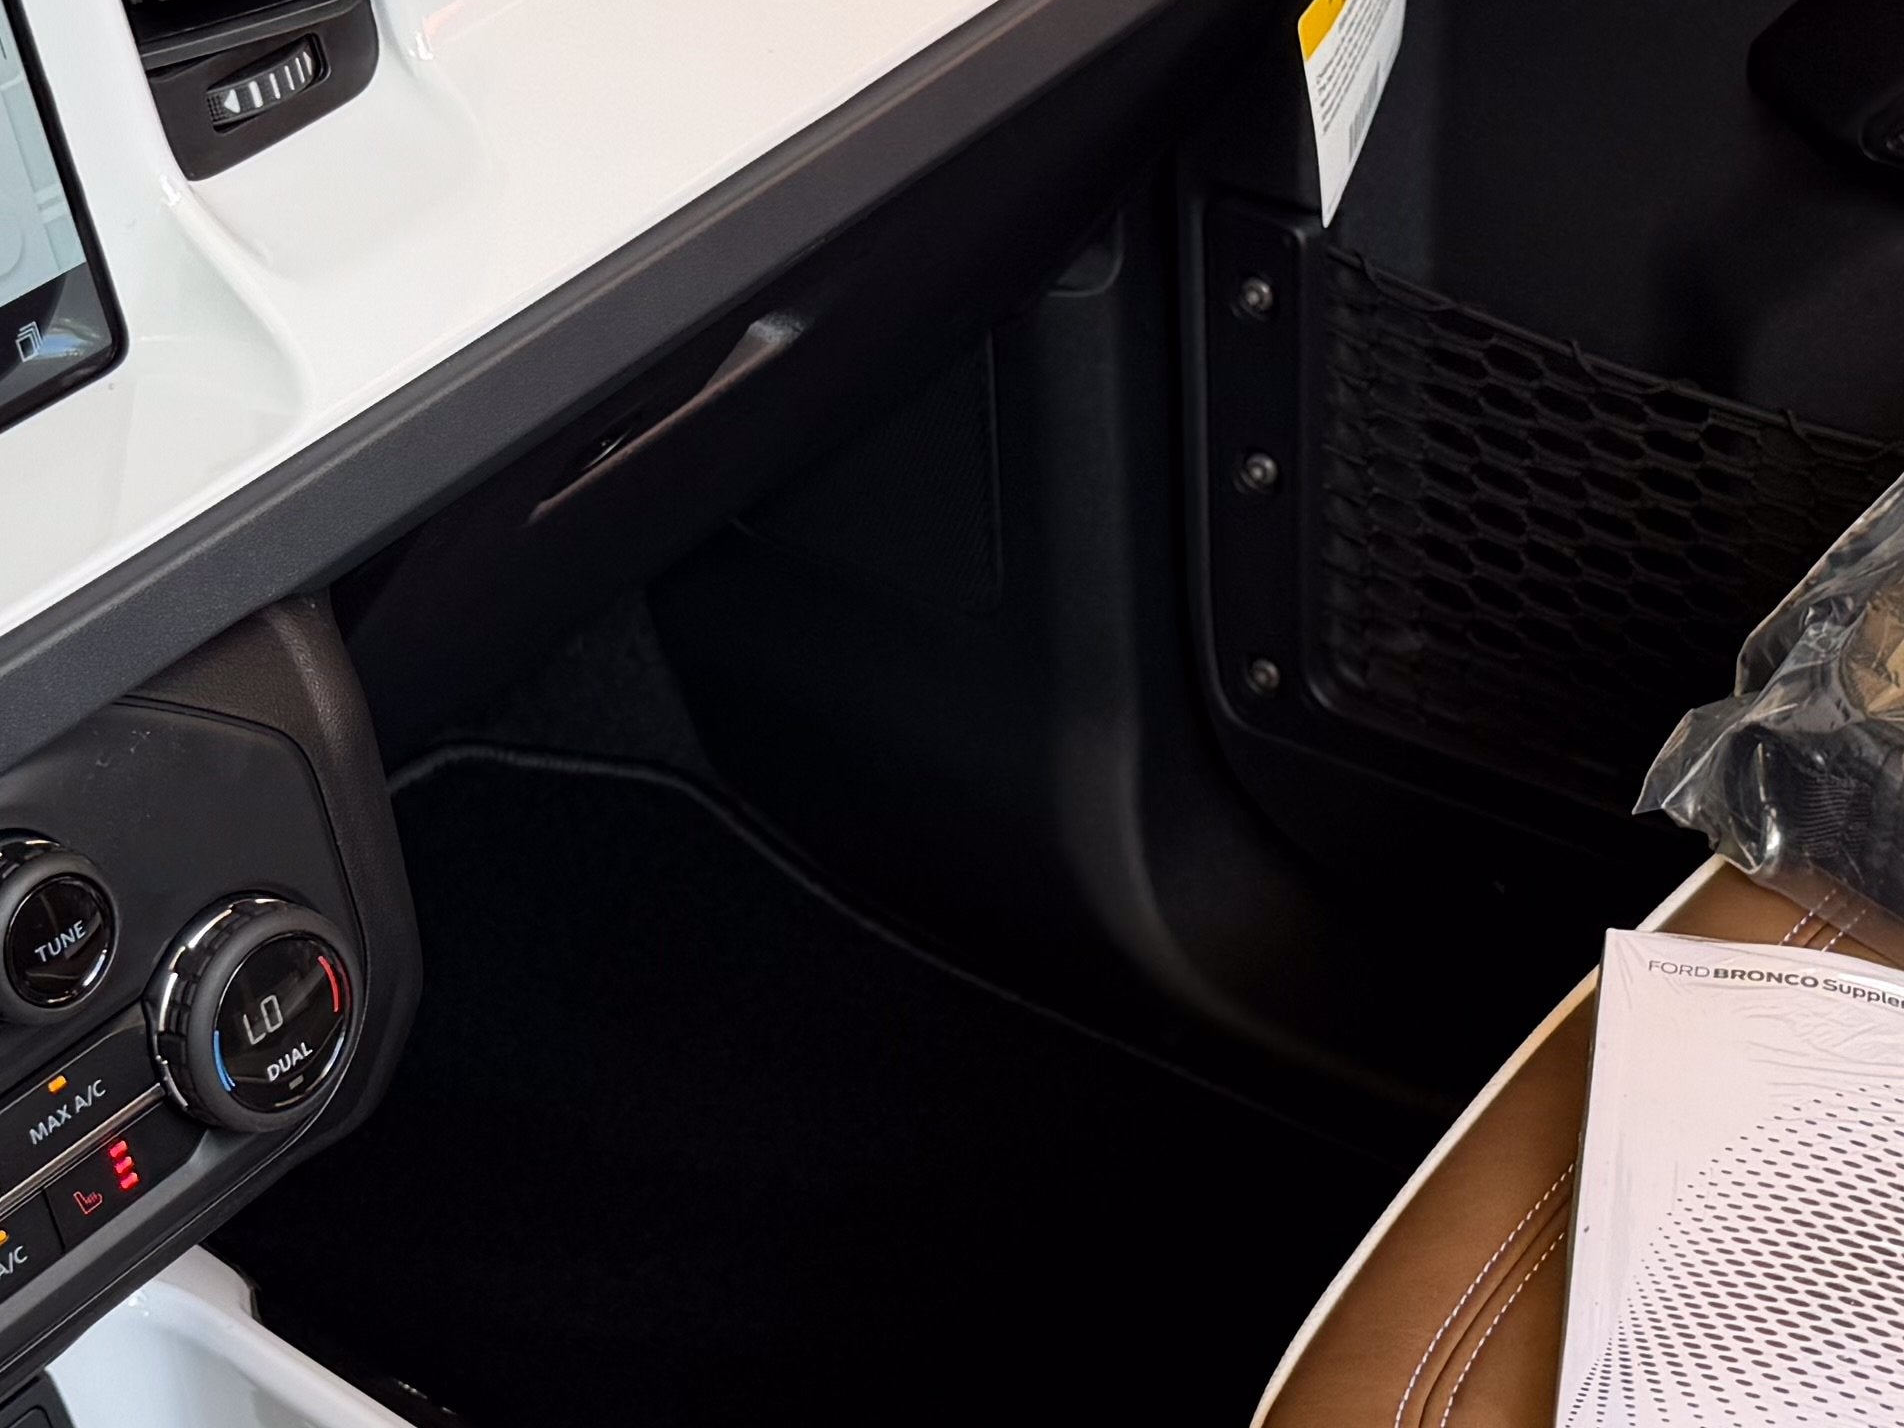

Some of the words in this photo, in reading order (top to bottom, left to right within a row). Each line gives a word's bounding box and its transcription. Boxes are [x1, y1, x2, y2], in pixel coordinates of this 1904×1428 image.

[34, 918, 87, 964] TUNE
[1648, 960, 1710, 978] FORD
[1713, 968, 1819, 988] BRONCO
[242, 993, 284, 1046] LO
[266, 1041, 314, 1083] DUAL
[29, 1106, 73, 1146] MAX
[72, 1078, 108, 1113] A/C
